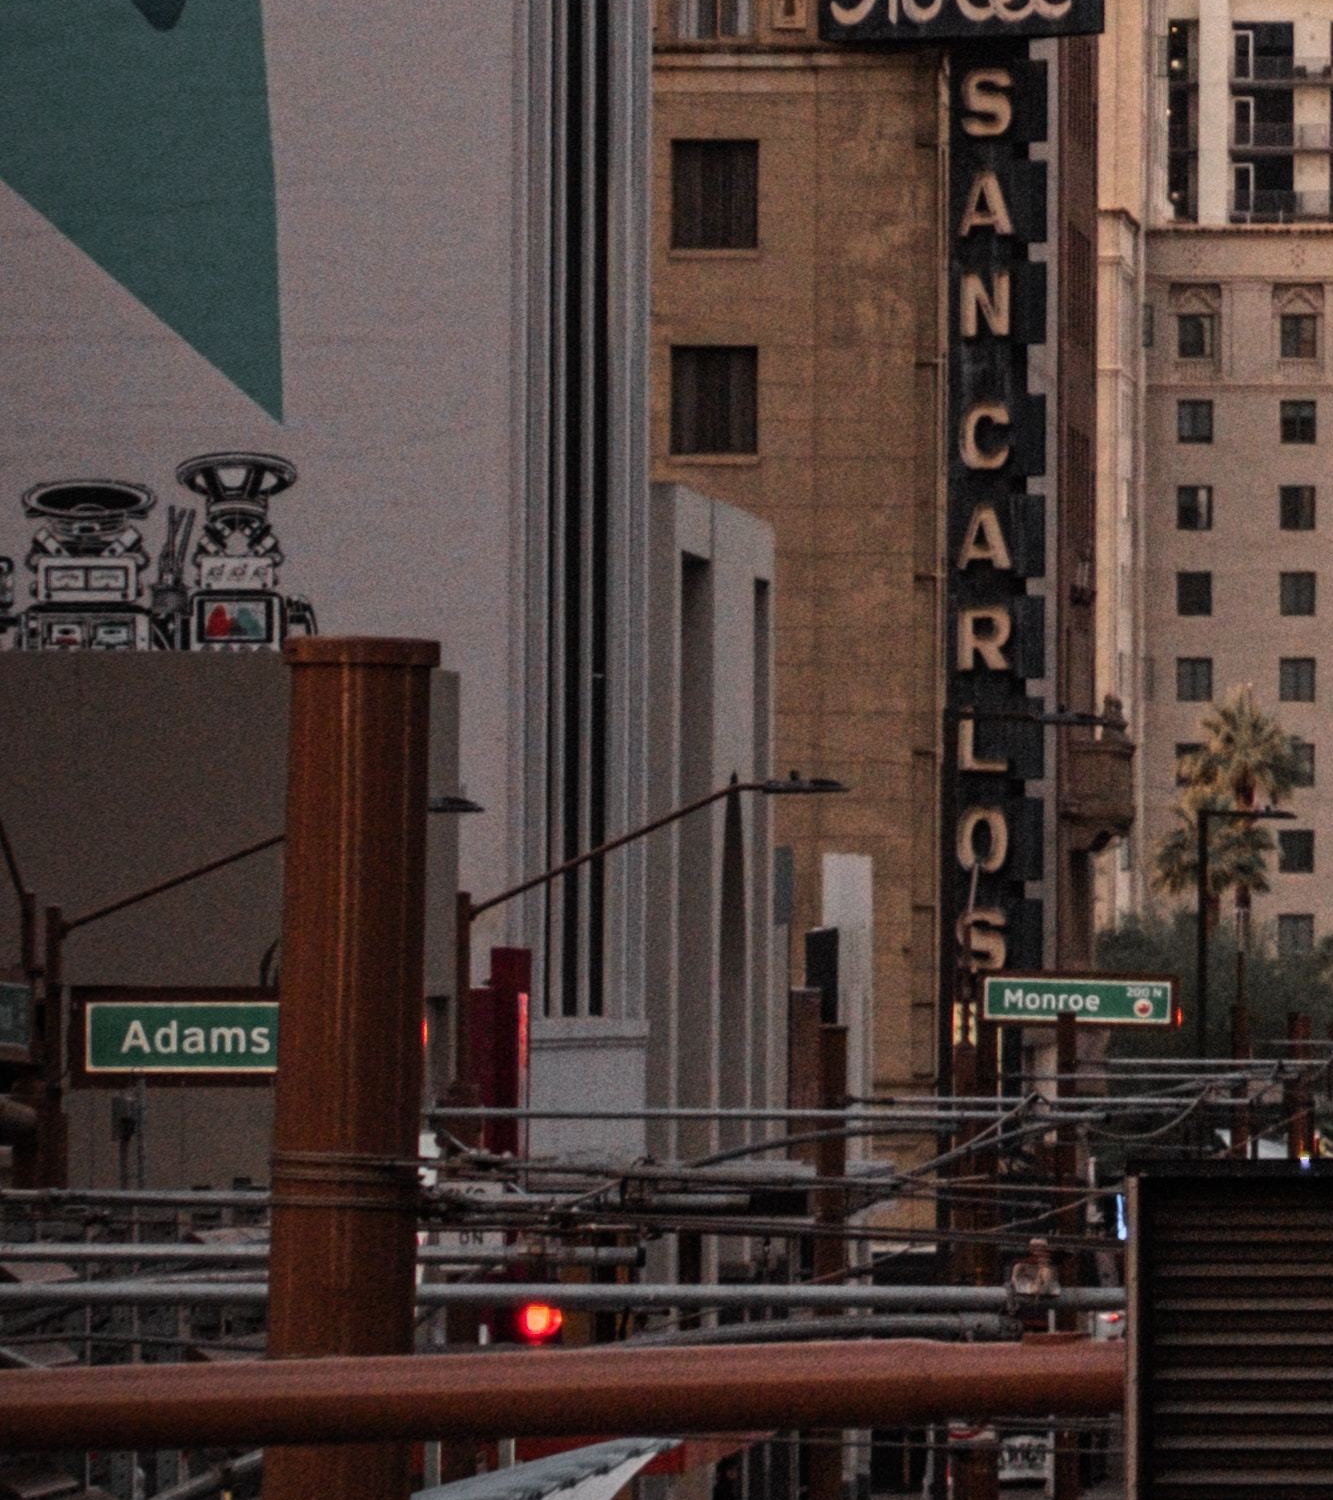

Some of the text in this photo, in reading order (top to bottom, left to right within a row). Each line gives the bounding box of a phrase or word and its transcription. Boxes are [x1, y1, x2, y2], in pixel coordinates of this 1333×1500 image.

[956, 67, 1014, 973] SAN CARLOS
[1003, 987, 1100, 1012] Monroe
[120, 1018, 271, 1054] Adams
